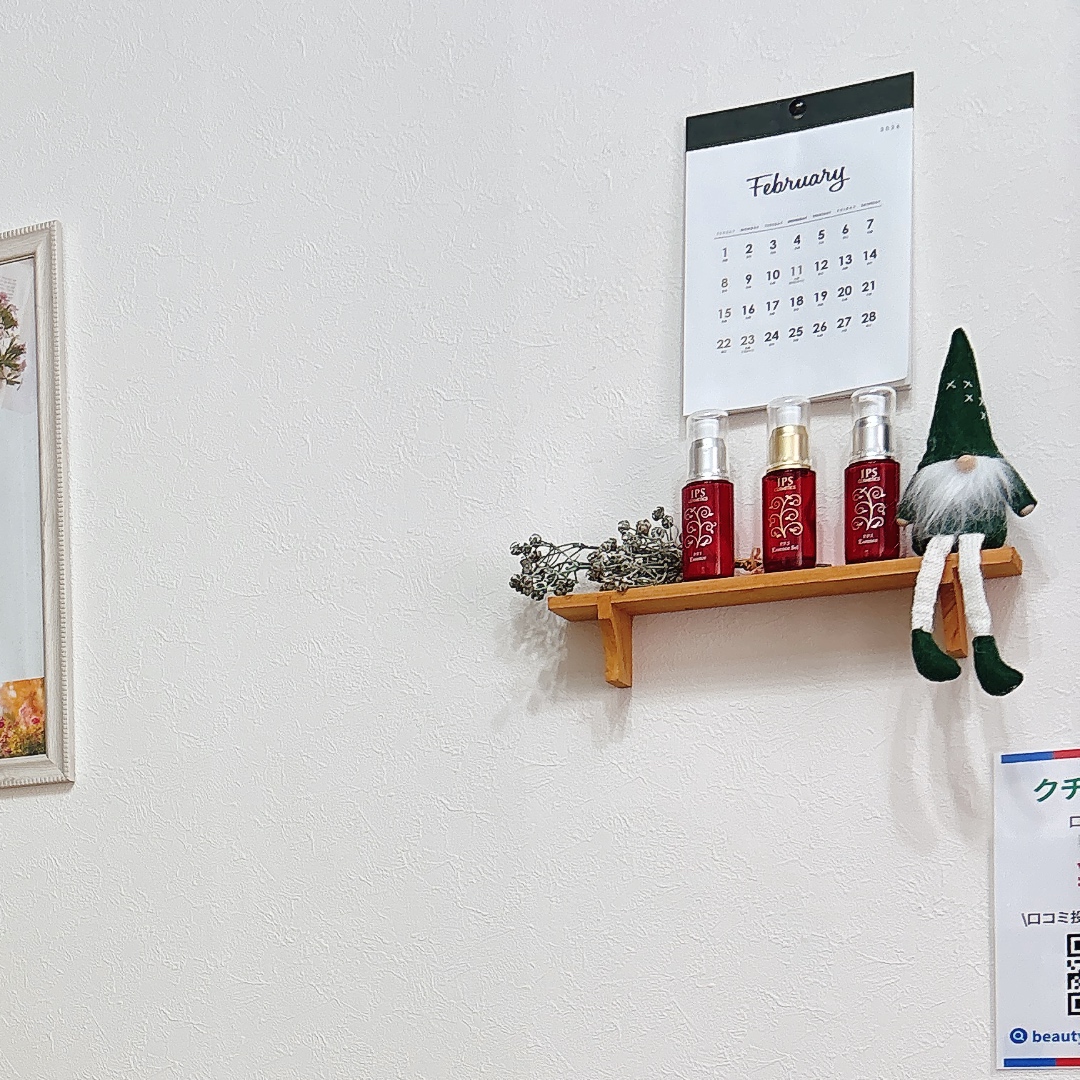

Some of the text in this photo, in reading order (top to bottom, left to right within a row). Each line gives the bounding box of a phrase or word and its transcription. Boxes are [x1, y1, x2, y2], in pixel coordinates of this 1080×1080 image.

[746, 166, 851, 197] February
[722, 218, 874, 258] 1 2 3 4 5 6 7
[721, 278, 728, 288] 8
[745, 274, 752, 286] 9
[766, 270, 780, 281] 10
[790, 265, 803, 276] 11
[814, 260, 828, 272] 12
[838, 254, 852, 266] 13
[863, 248, 877, 261] 14
[718, 280, 875, 319] 15 16 17 18 19 20 21
[716, 338, 732, 350] 22
[740, 334, 755, 346] 23
[764, 330, 780, 342] 24
[788, 326, 804, 338] 25
[812, 322, 828, 334] 26
[836, 316, 852, 328] 27
[861, 311, 877, 324] 28
[777, 476, 794, 487] IPS
[861, 466, 878, 478] IPS
[690, 488, 706, 498] IPS
